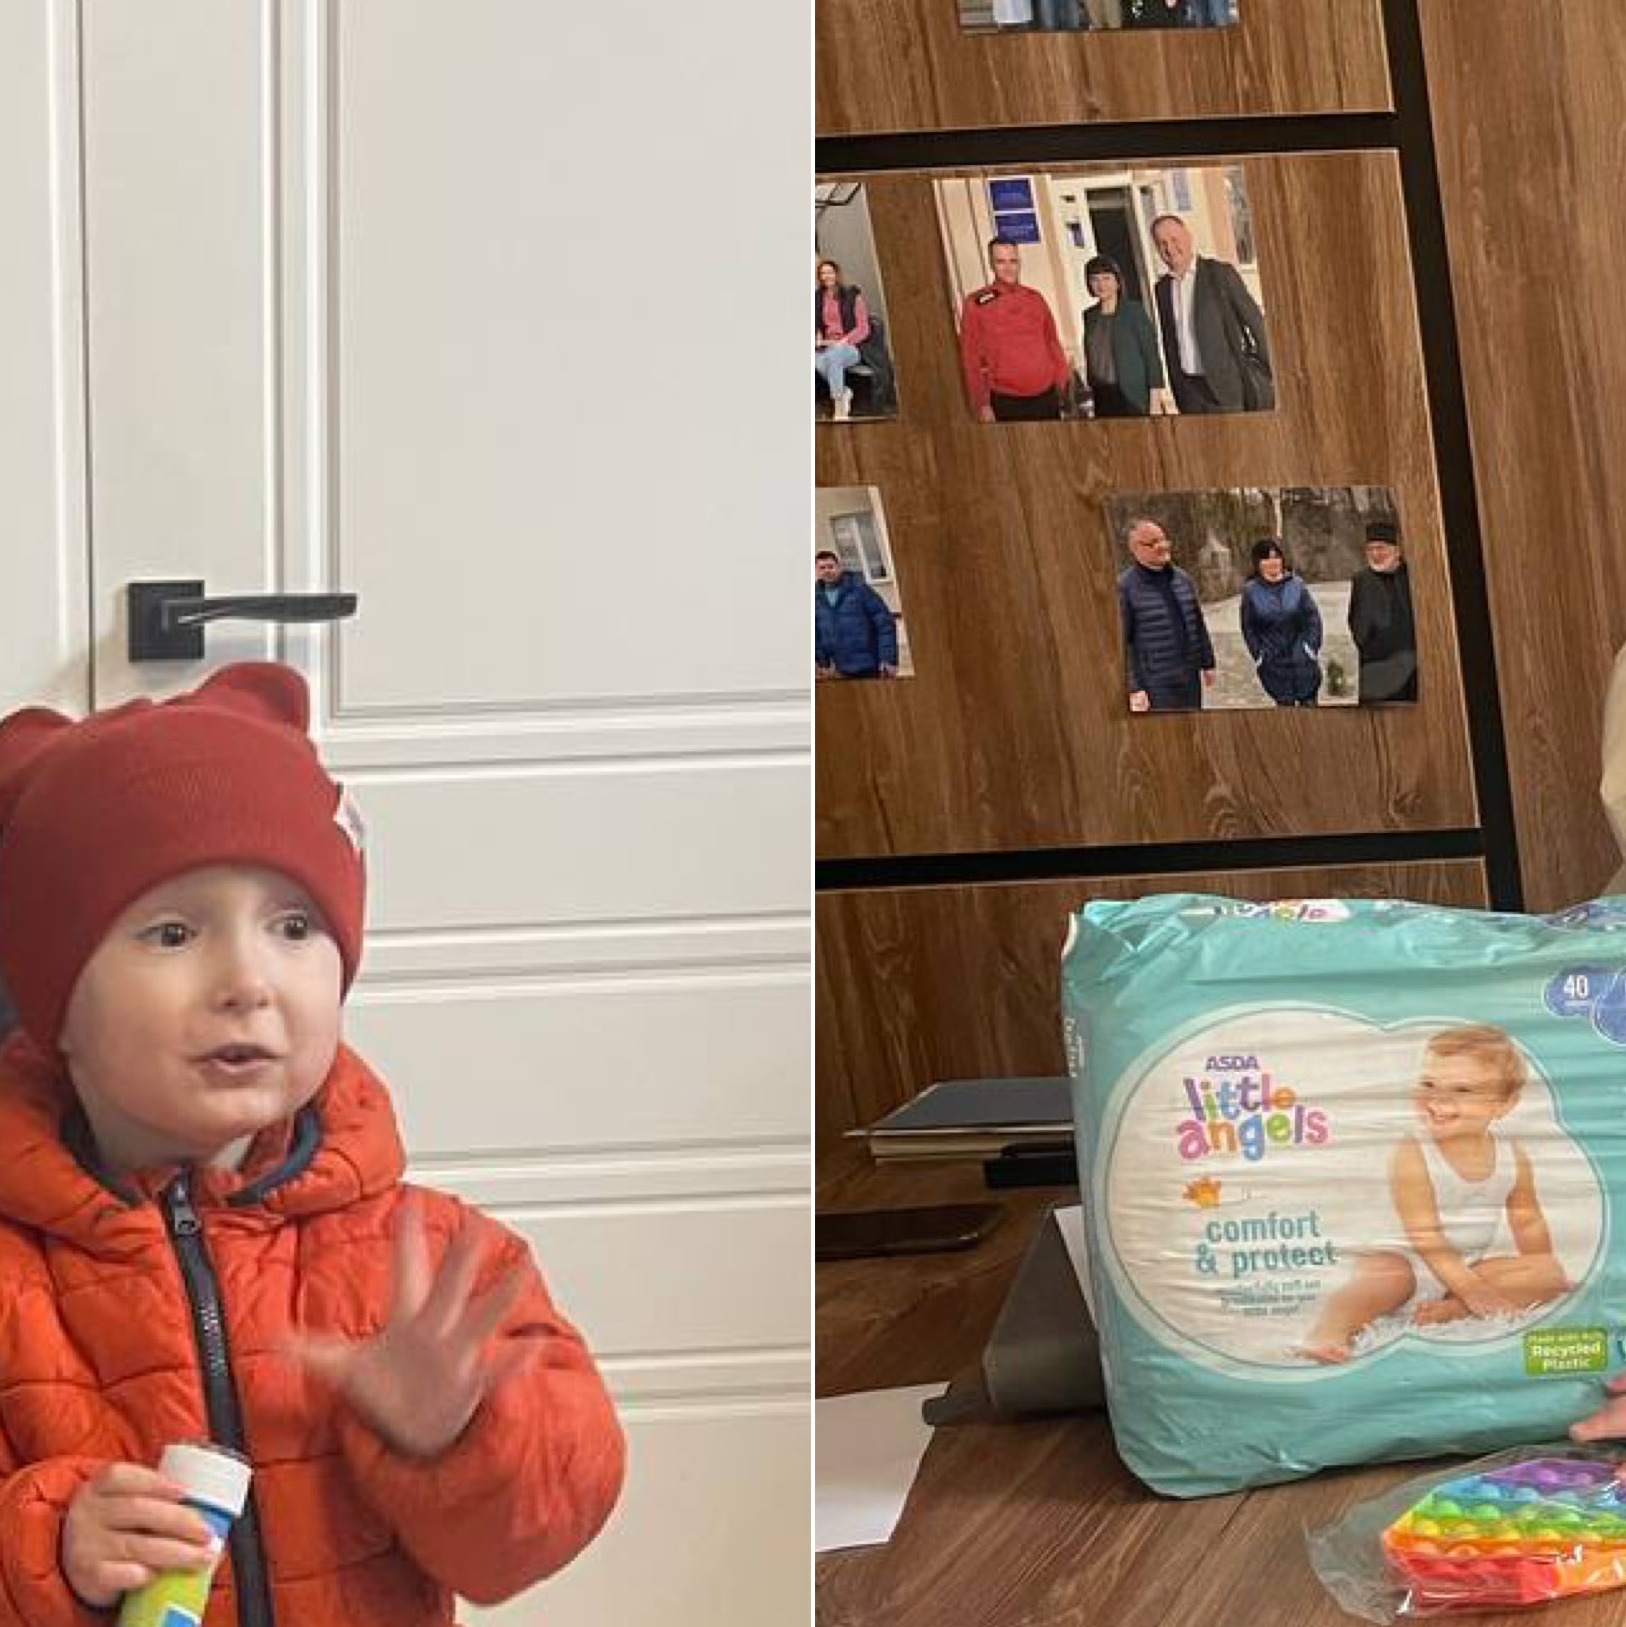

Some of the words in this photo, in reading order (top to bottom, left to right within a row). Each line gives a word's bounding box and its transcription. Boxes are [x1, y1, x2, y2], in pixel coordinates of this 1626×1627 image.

[1563, 974, 1590, 1000] 40
[1205, 1056, 1261, 1071] ASDA
[1182, 1073, 1298, 1121] little
[1176, 1104, 1330, 1162] angels
[1206, 1209, 1322, 1243] comfort
[1231, 1239, 1339, 1279] protect
